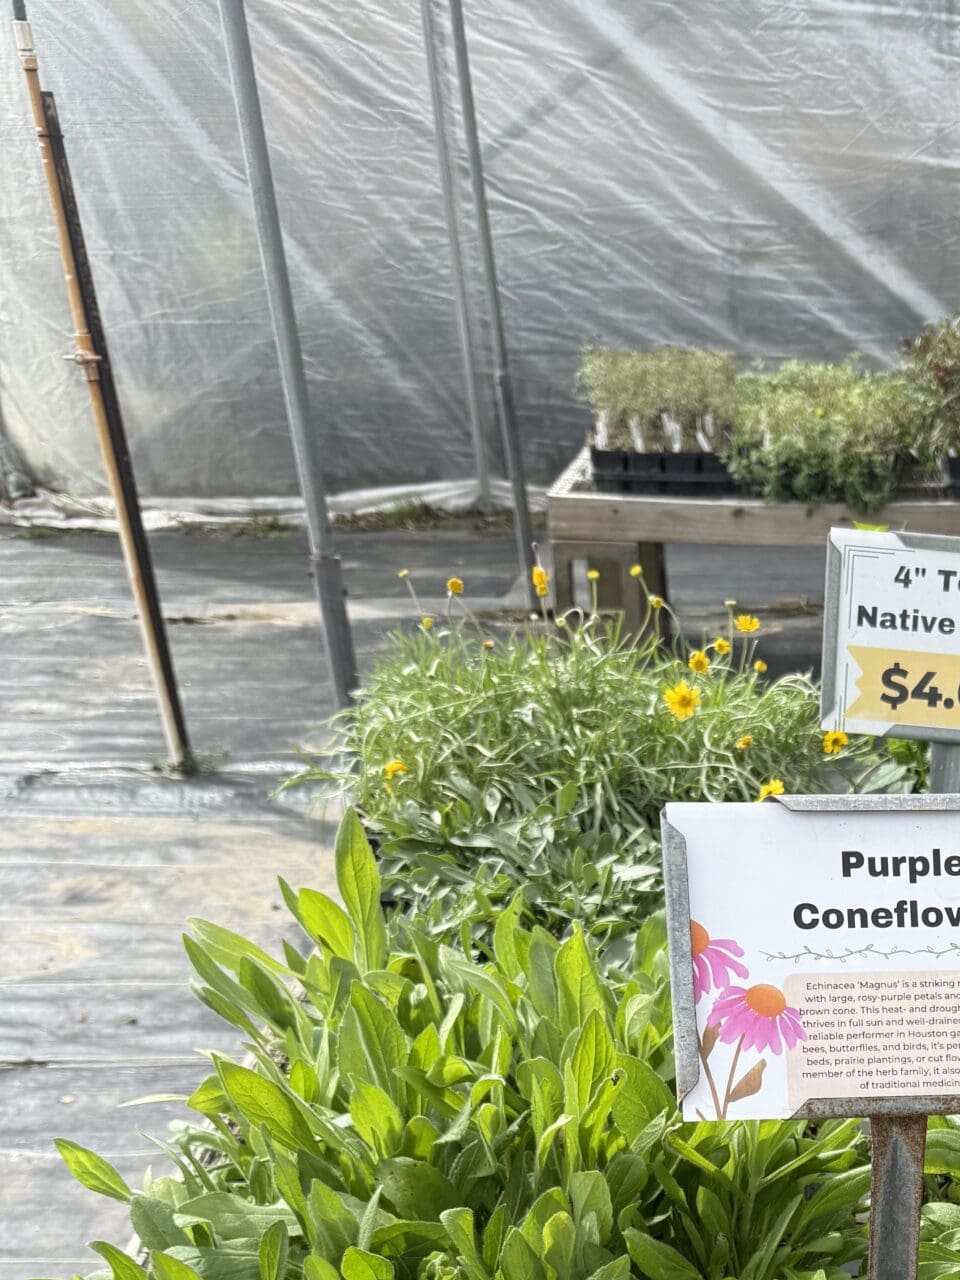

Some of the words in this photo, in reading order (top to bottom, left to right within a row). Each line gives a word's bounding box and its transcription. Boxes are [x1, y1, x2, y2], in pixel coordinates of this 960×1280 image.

[894, 566, 926, 588] 4"
[857, 605, 955, 634] Native
[806, 982, 855, 990] Echinacea
[902, 980, 909, 988] is
[920, 980, 955, 989] striking
[805, 995, 826, 1003] with
[829, 995, 855, 1003] large,
[858, 993, 911, 1003] rosy-purple
[914, 992, 942, 1001] petals
[910, 1005, 926, 1013] and
[802, 1020, 835, 1028] thrives
[838, 1019, 846, 1027] in
[849, 1019, 863, 1027] full
[886, 1018, 903, 1026] and
[809, 1032, 844, 1040] reliable
[846, 1031, 894, 1040] performer
[897, 1030, 905, 1038] in
[909, 1029, 948, 1038] Houston
[803, 1046, 827, 1054] bees,
[829, 1044, 880, 1052] butterflies,
[883, 1043, 900, 1051] and
[904, 1042, 929, 1051] birds,
[807, 1058, 832, 1066] beds,
[835, 1057, 865, 1066] prairie
[867, 1056, 914, 1065] plantings,
[803, 1070, 843, 1078] member
[846, 1069, 856, 1077] of
[900, 1066, 932, 1076] family,
[934, 1067, 940, 1075] it
[872, 1080, 919, 1089] traditional
